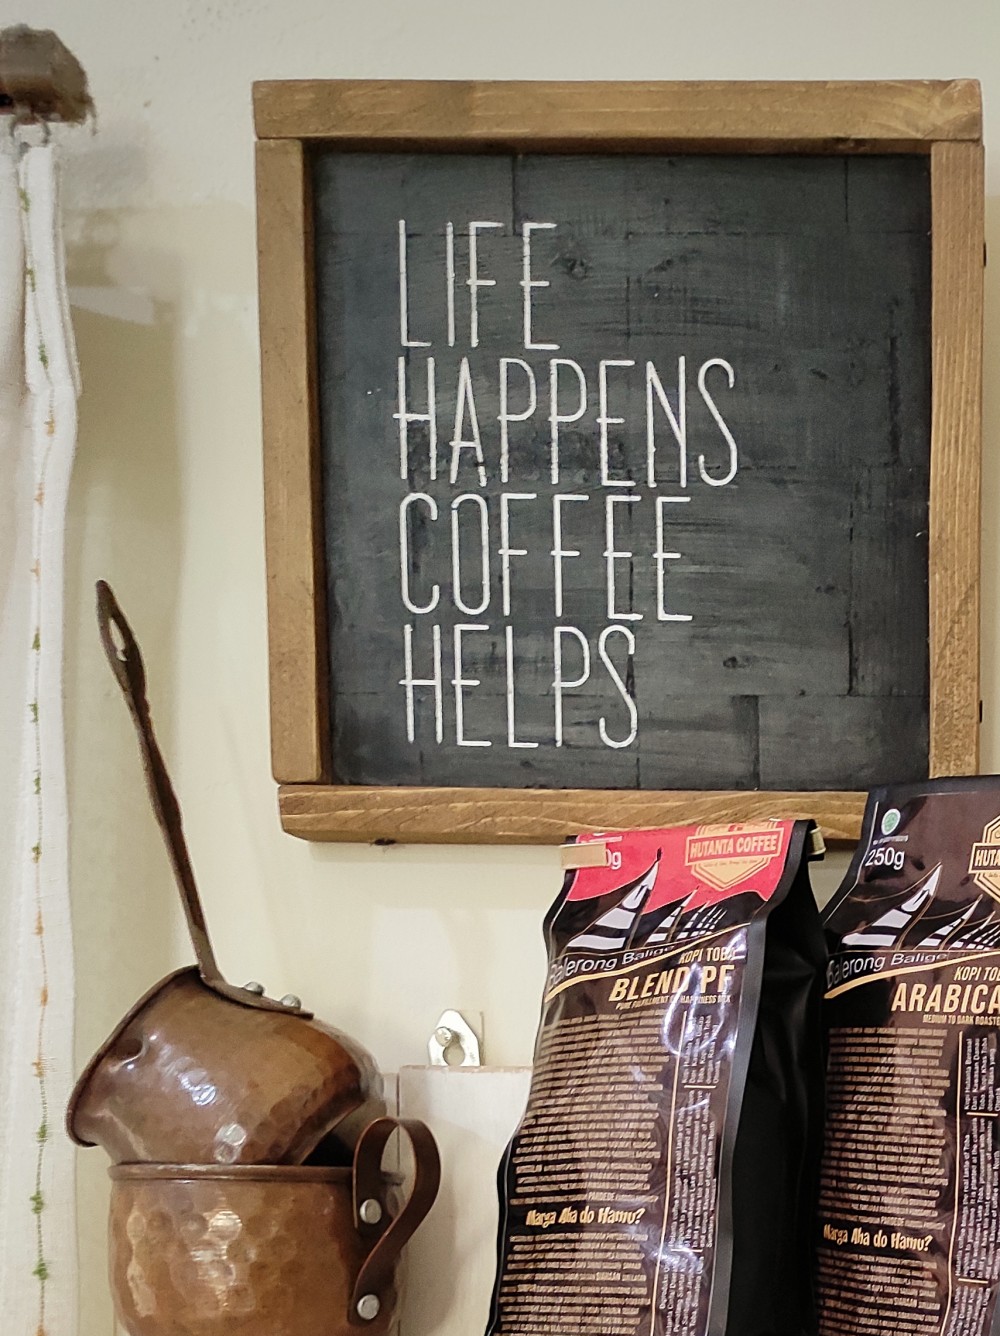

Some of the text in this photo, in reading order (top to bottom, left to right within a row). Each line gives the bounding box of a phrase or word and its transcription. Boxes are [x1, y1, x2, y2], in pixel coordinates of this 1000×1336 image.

[399, 219, 560, 350] LIFE
[393, 356, 738, 488] HAPPENS
[400, 493, 693, 621] COFFEE
[400, 624, 639, 748] HELPS
[690, 834, 778, 858] HUTANTA COFFEE
[865, 847, 905, 870] 250g
[678, 949, 703, 964] KOPI
[609, 967, 689, 1002] BLEND
[953, 966, 981, 982] KOPI
[526, 1208, 556, 1229] Marga
[579, 1206, 594, 1224] do
[597, 1206, 646, 1225] Hamu?
[823, 1224, 933, 1252] Marga Aha do Hamu?
